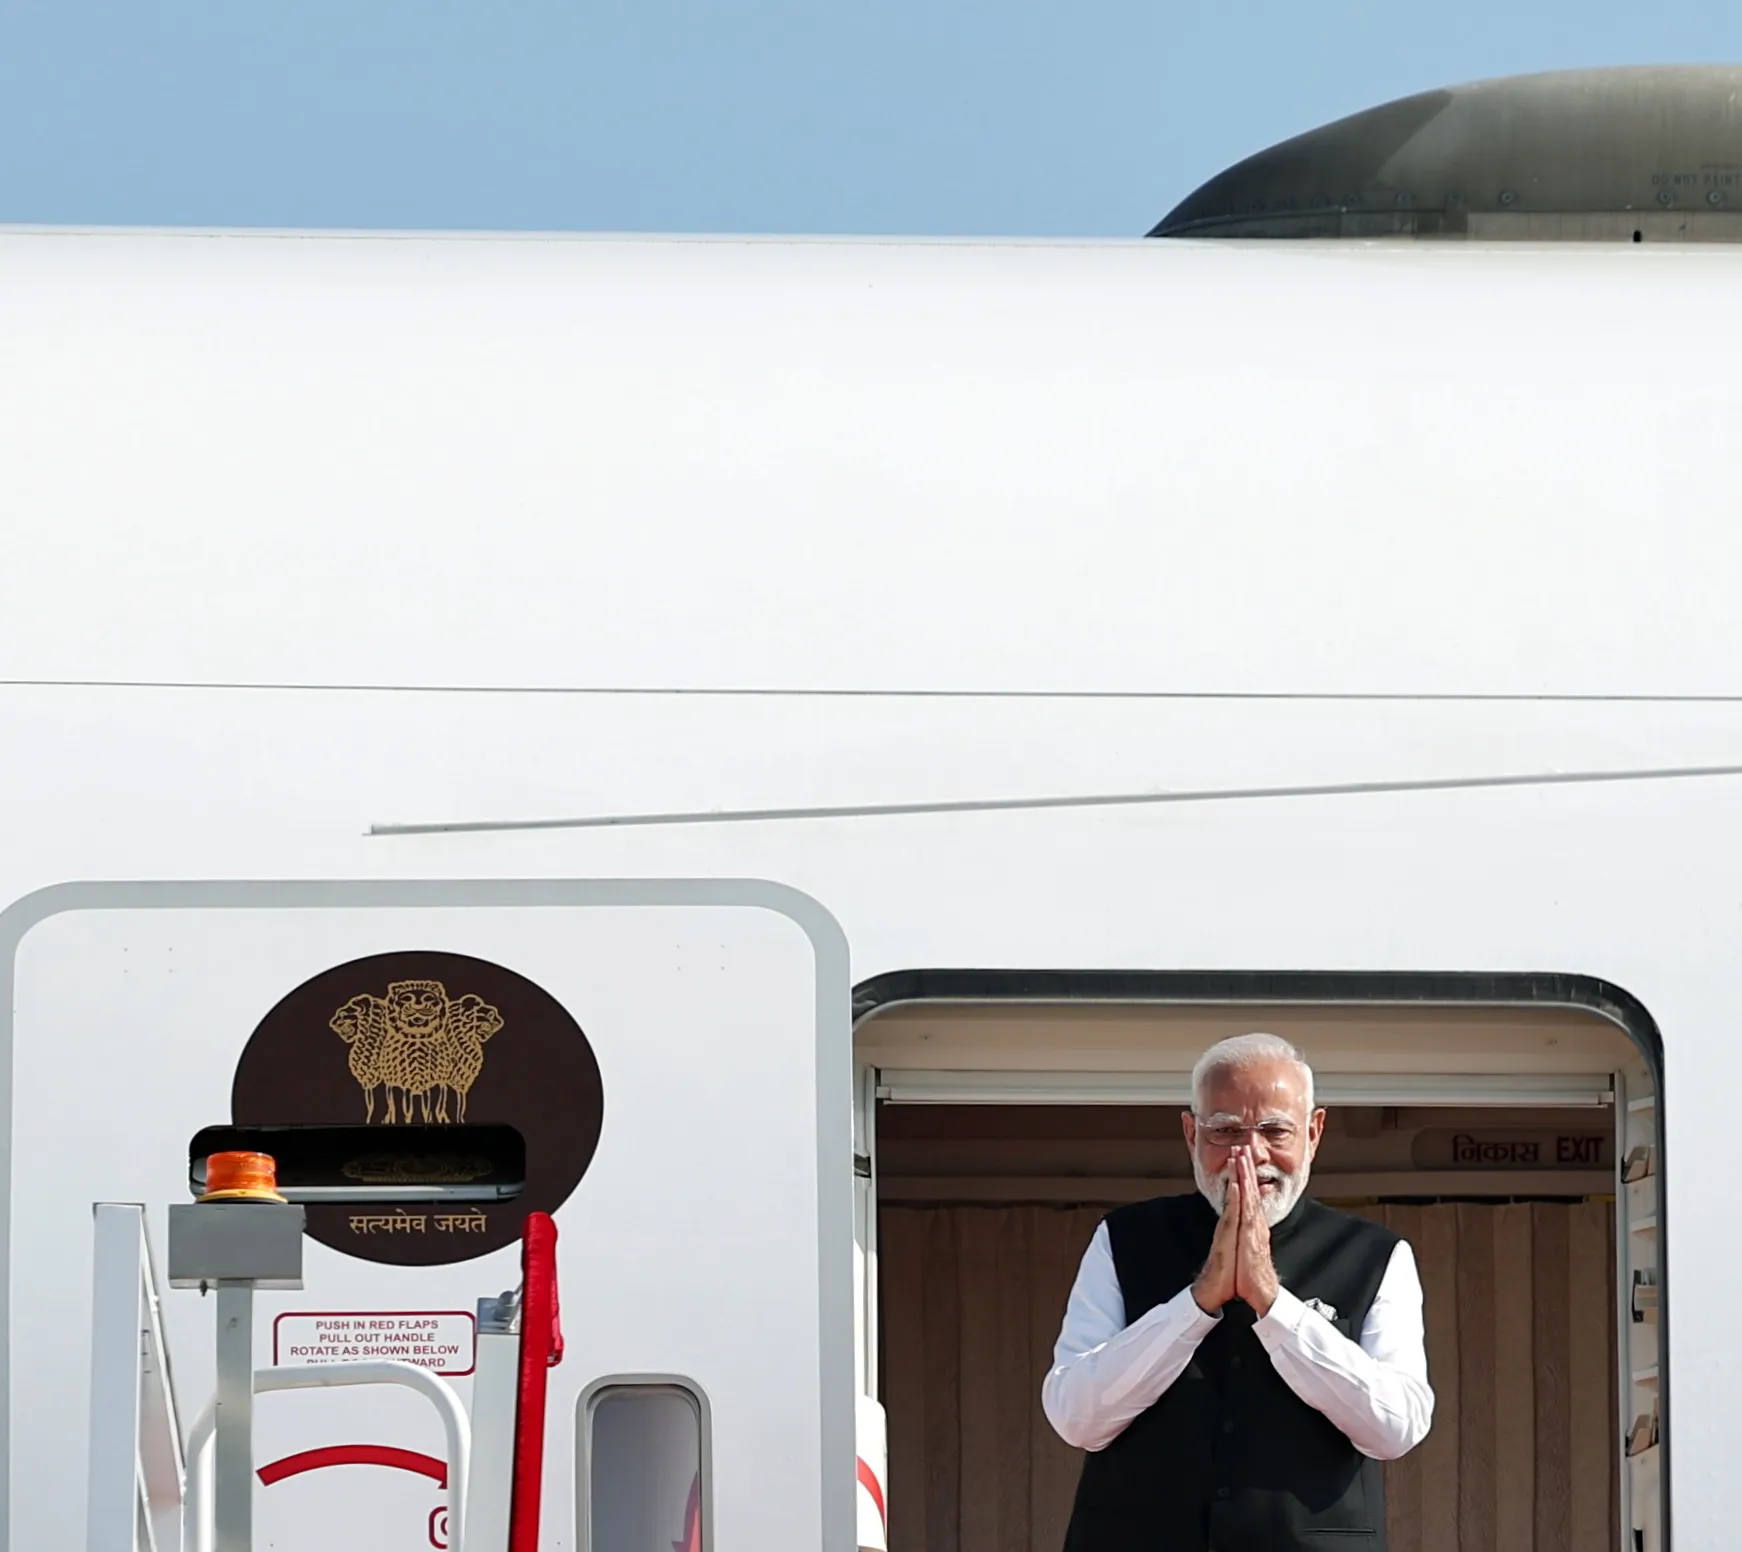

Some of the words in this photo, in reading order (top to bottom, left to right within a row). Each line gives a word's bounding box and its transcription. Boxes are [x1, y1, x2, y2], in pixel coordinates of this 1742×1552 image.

[1452, 1133, 1541, 1163] निकास
[1556, 1136, 1604, 1163] EXIT
[349, 1208, 427, 1234] सत्यमेव
[433, 1207, 487, 1233] जयते
[315, 1320, 350, 1330] PUSH
[353, 1320, 365, 1330] IN
[369, 1320, 395, 1330] RED
[399, 1320, 438, 1330] FLAPS
[319, 1333, 351, 1343] PULL
[354, 1333, 380, 1343] OUT
[384, 1333, 435, 1343] HANDLE
[290, 1346, 339, 1356] ROTATE
[341, 1346, 358, 1355] AS
[362, 1346, 410, 1355] SHOWN
[413, 1345, 459, 1355] BELOW
